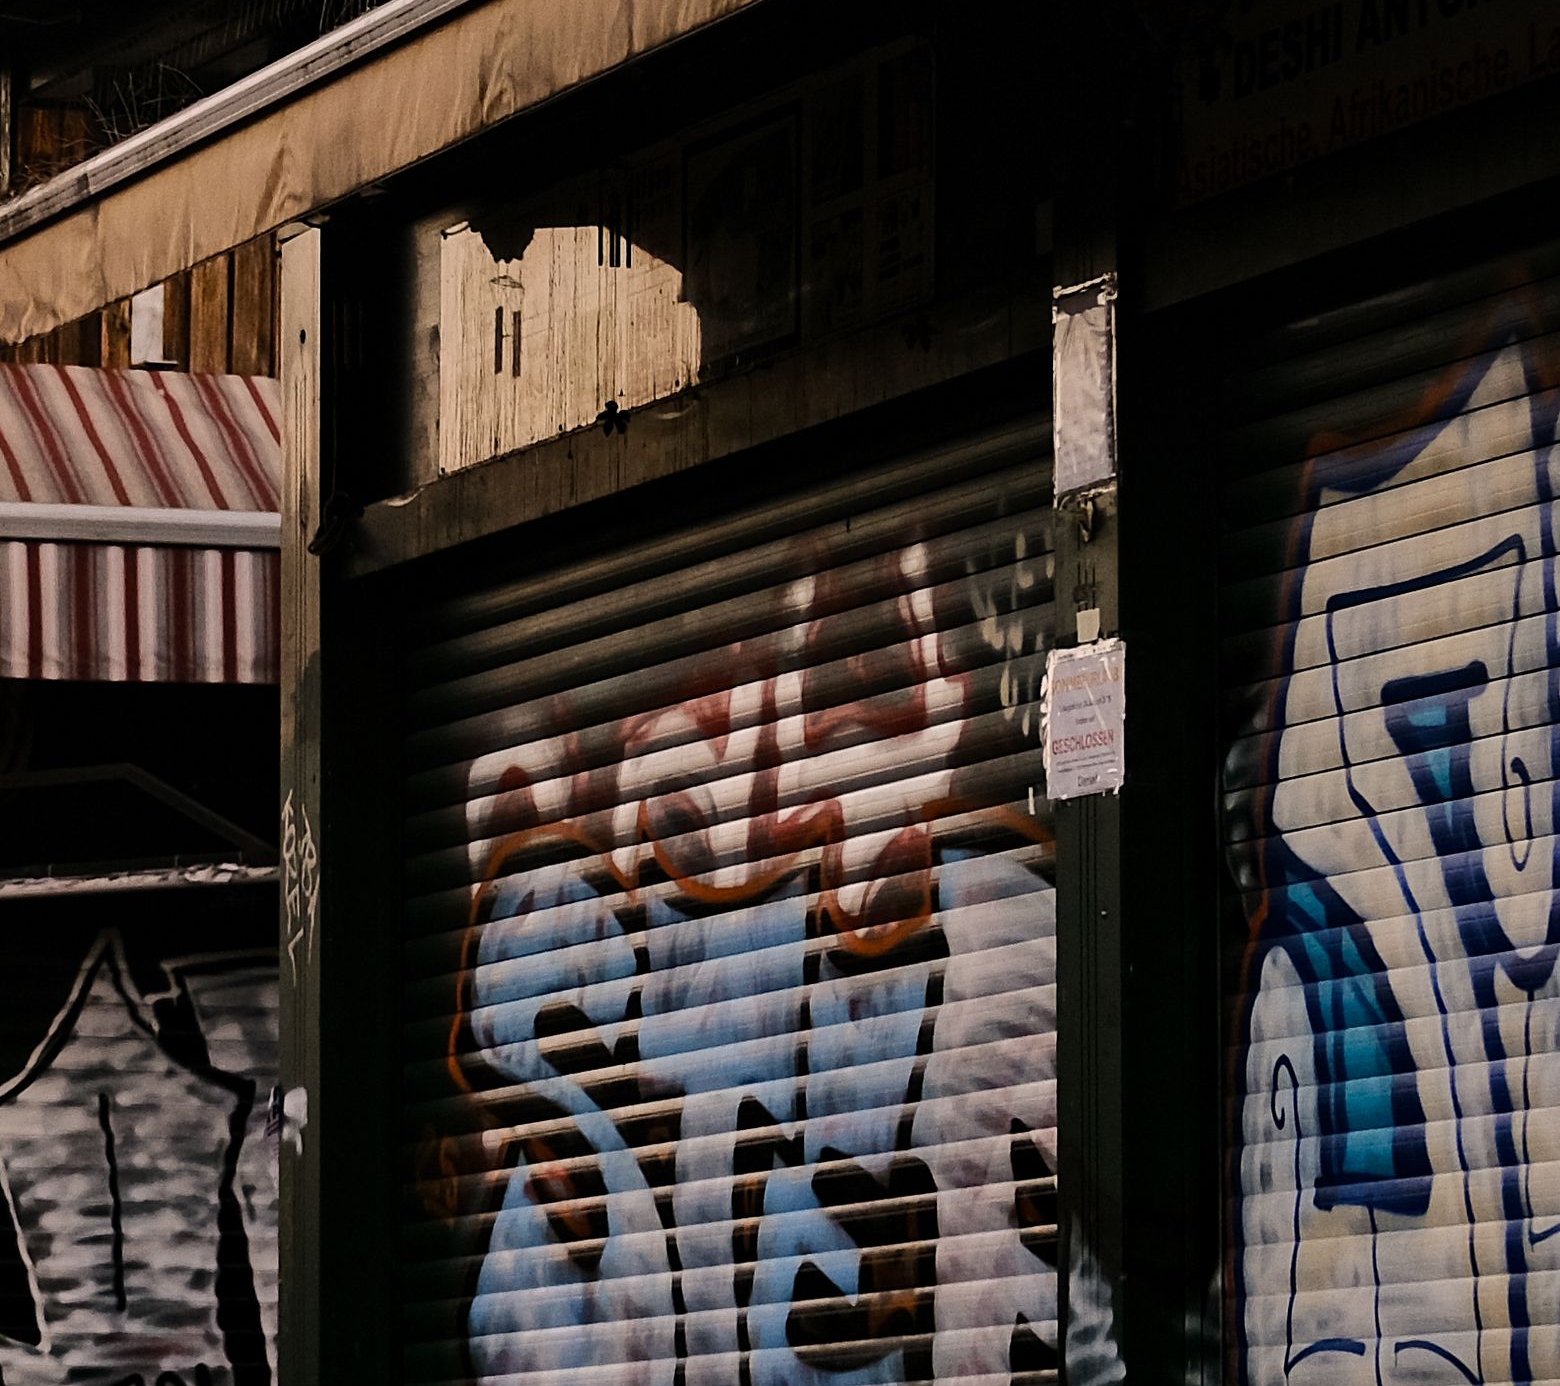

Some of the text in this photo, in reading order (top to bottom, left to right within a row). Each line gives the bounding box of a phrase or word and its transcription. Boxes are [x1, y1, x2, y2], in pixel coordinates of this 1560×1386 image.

[1234, 3, 1343, 101] DESHI
[1175, 117, 1316, 197] Asiatische,
[1329, 42, 1520, 143] Afrikanische,
[1051, 729, 1115, 756] GESCHLOSSEN
